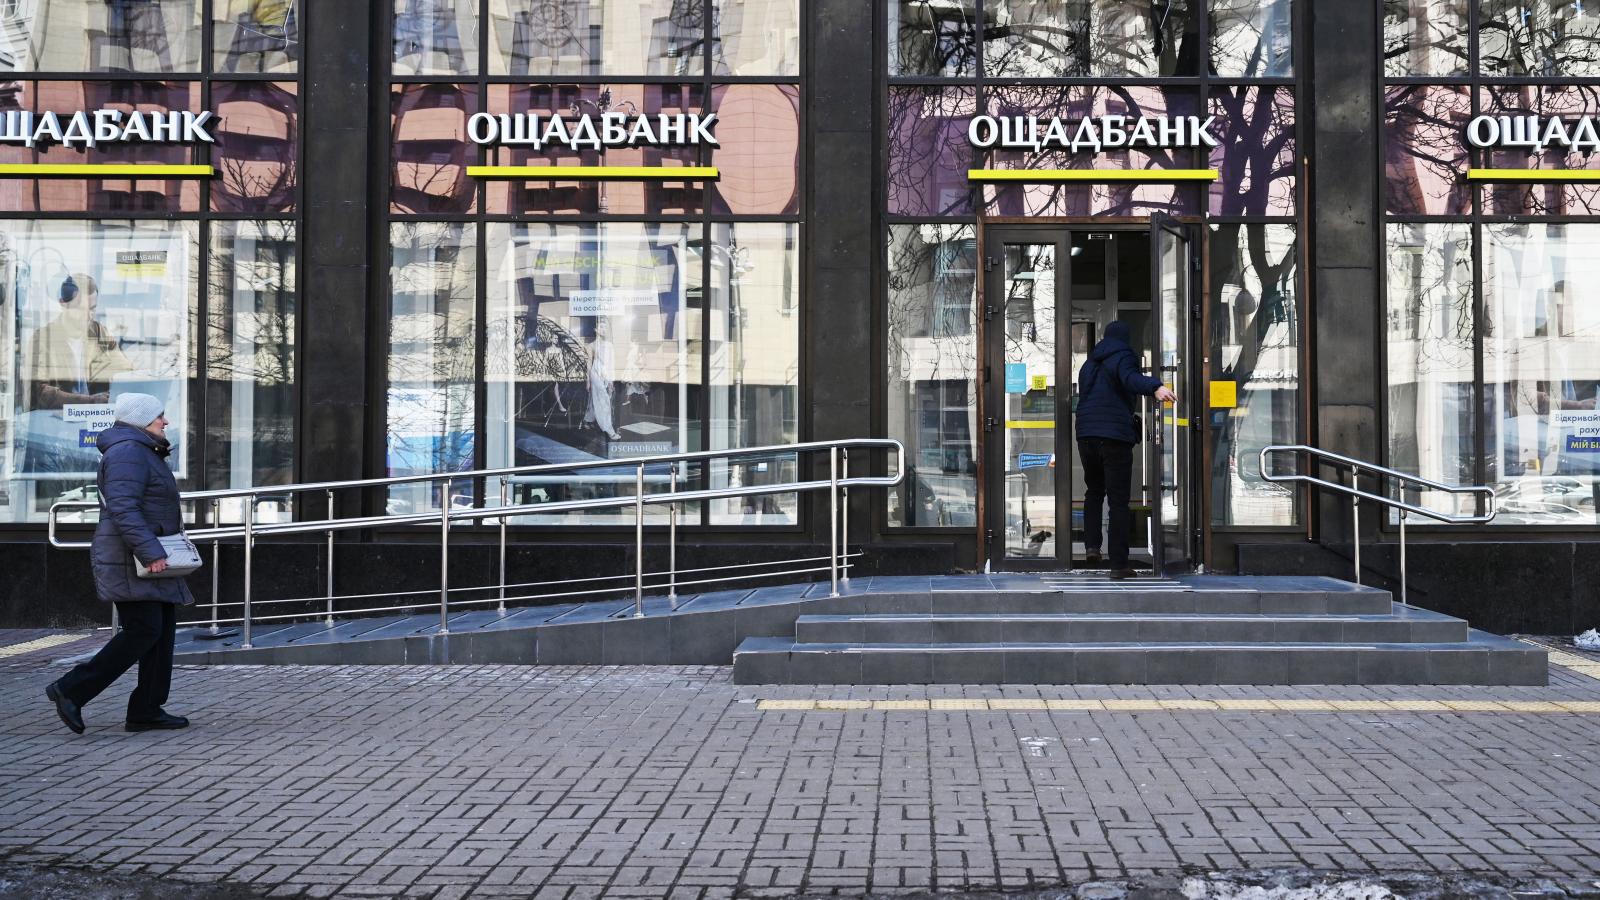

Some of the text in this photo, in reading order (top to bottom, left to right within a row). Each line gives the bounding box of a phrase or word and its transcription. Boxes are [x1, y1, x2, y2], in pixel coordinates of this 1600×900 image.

[467, 111, 718, 150] ОЩАДБАНК
[968, 115, 1217, 152] ОЩАДБАНК
[1571, 439, 1589, 448] МІЙ
